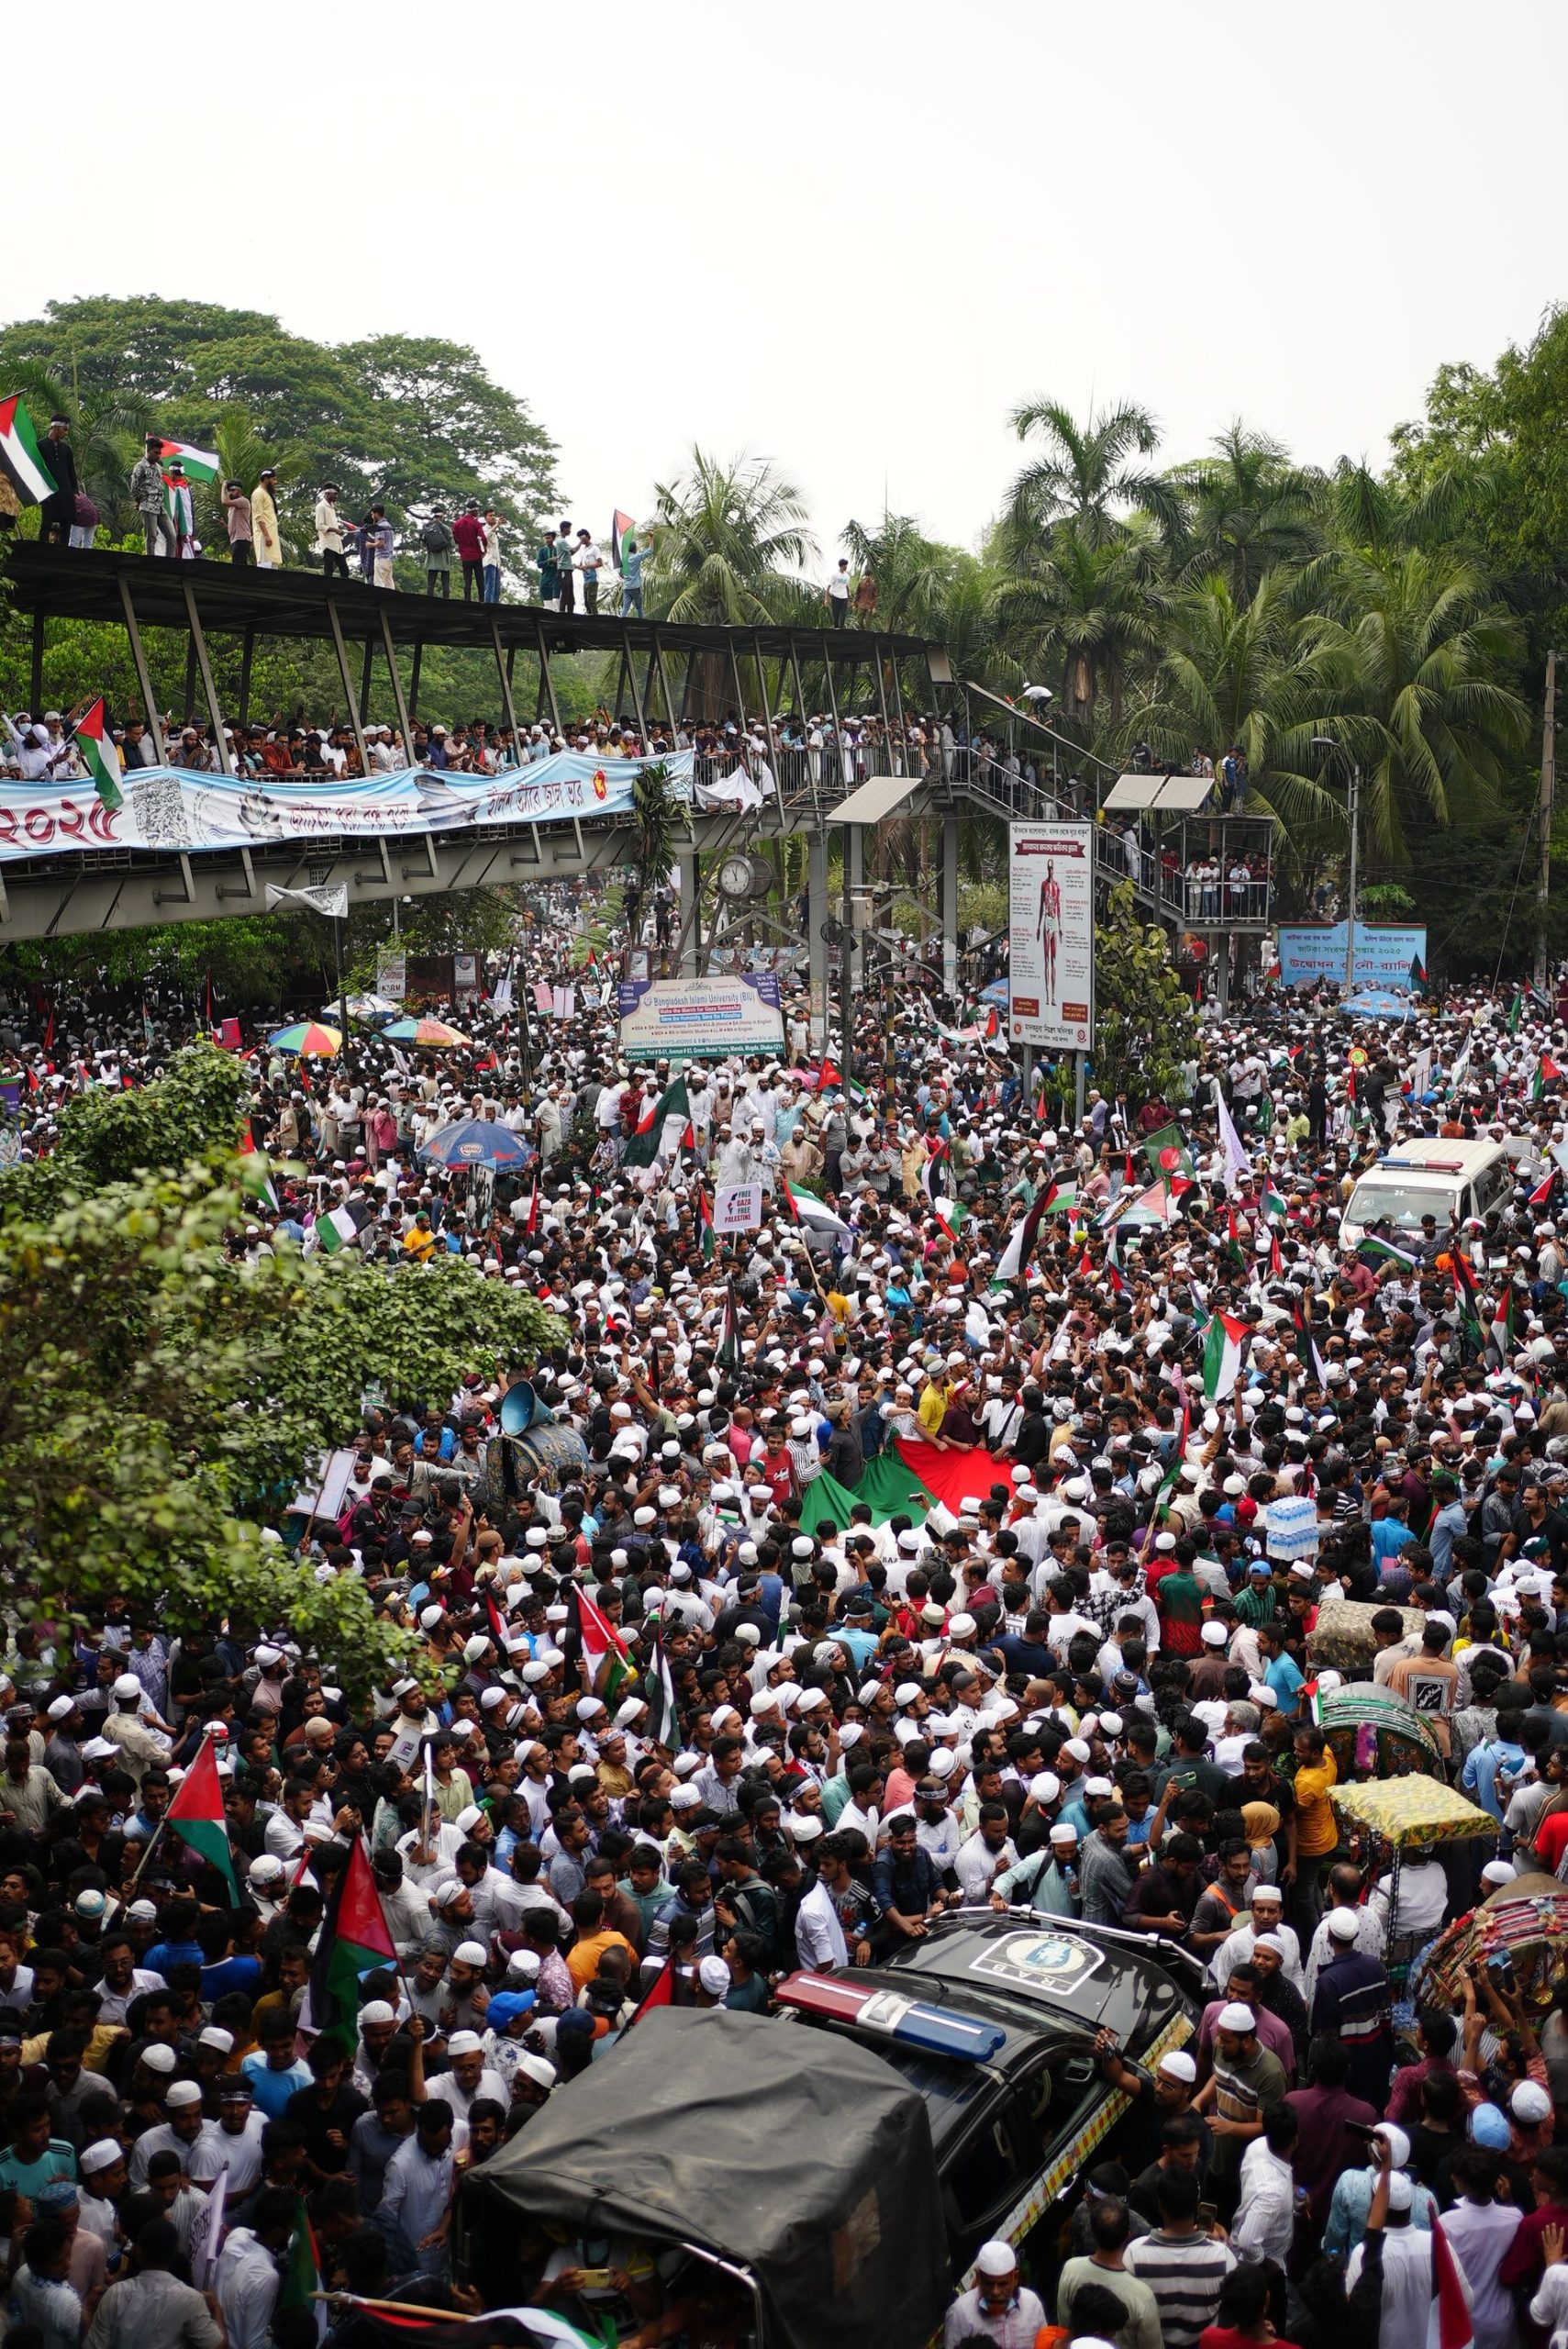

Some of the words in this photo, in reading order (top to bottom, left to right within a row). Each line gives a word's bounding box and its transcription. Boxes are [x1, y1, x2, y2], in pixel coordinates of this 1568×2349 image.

[653, 996, 688, 1008] Bangladesh
[689, 995, 707, 1004] Islami
[709, 992, 739, 1004] University
[740, 991, 755, 1003] (BIU)
[739, 1190, 751, 1198] FREE
[737, 1198, 751, 1207] GAZA
[738, 1207, 751, 1215] FREE
[725, 1214, 751, 1223] PALESTINE
